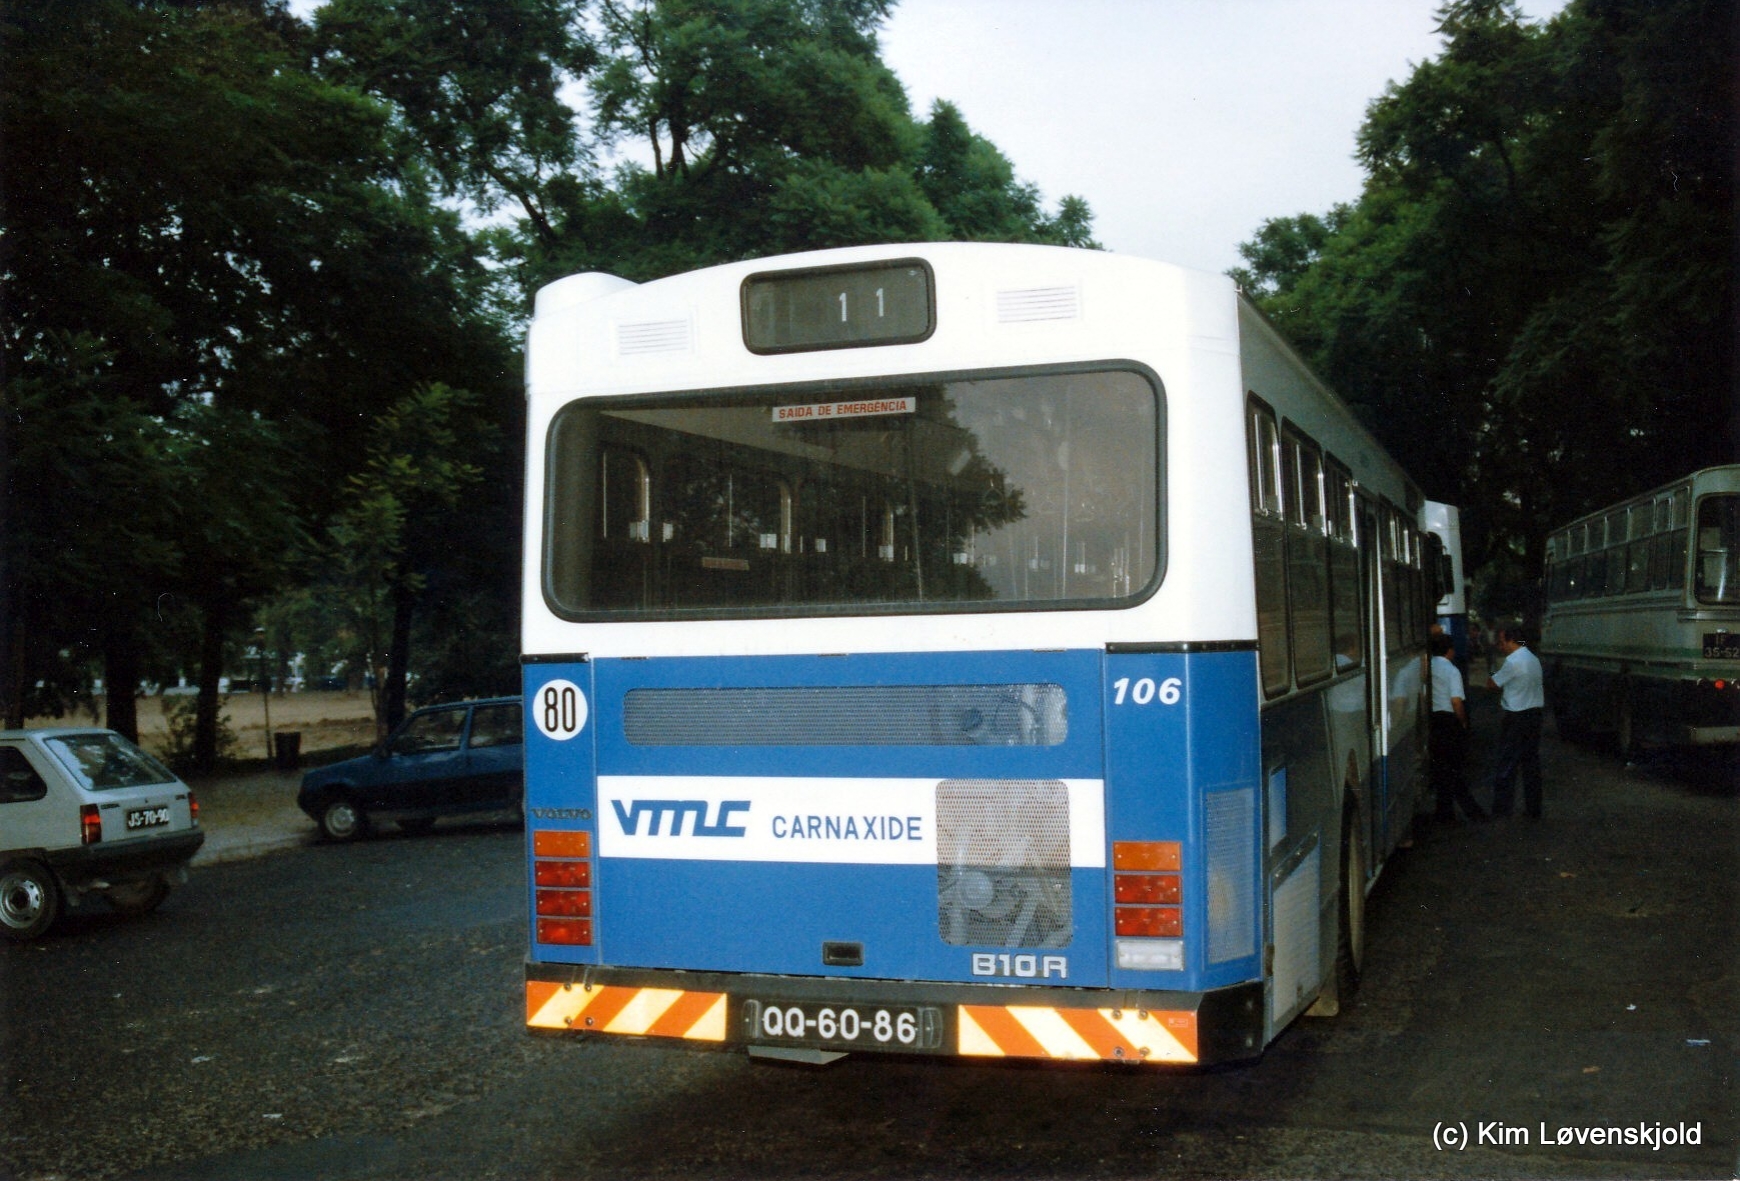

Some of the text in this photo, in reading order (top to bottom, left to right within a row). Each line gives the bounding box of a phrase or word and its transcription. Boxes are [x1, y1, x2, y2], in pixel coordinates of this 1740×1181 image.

[818, 405, 832, 416] DE
[1113, 677, 1182, 705] 106
[544, 686, 576, 733] 80
[531, 808, 592, 820] VOLVO
[772, 815, 923, 841] CARNAXIDE
[763, 1006, 917, 1044] QQ-60-86
